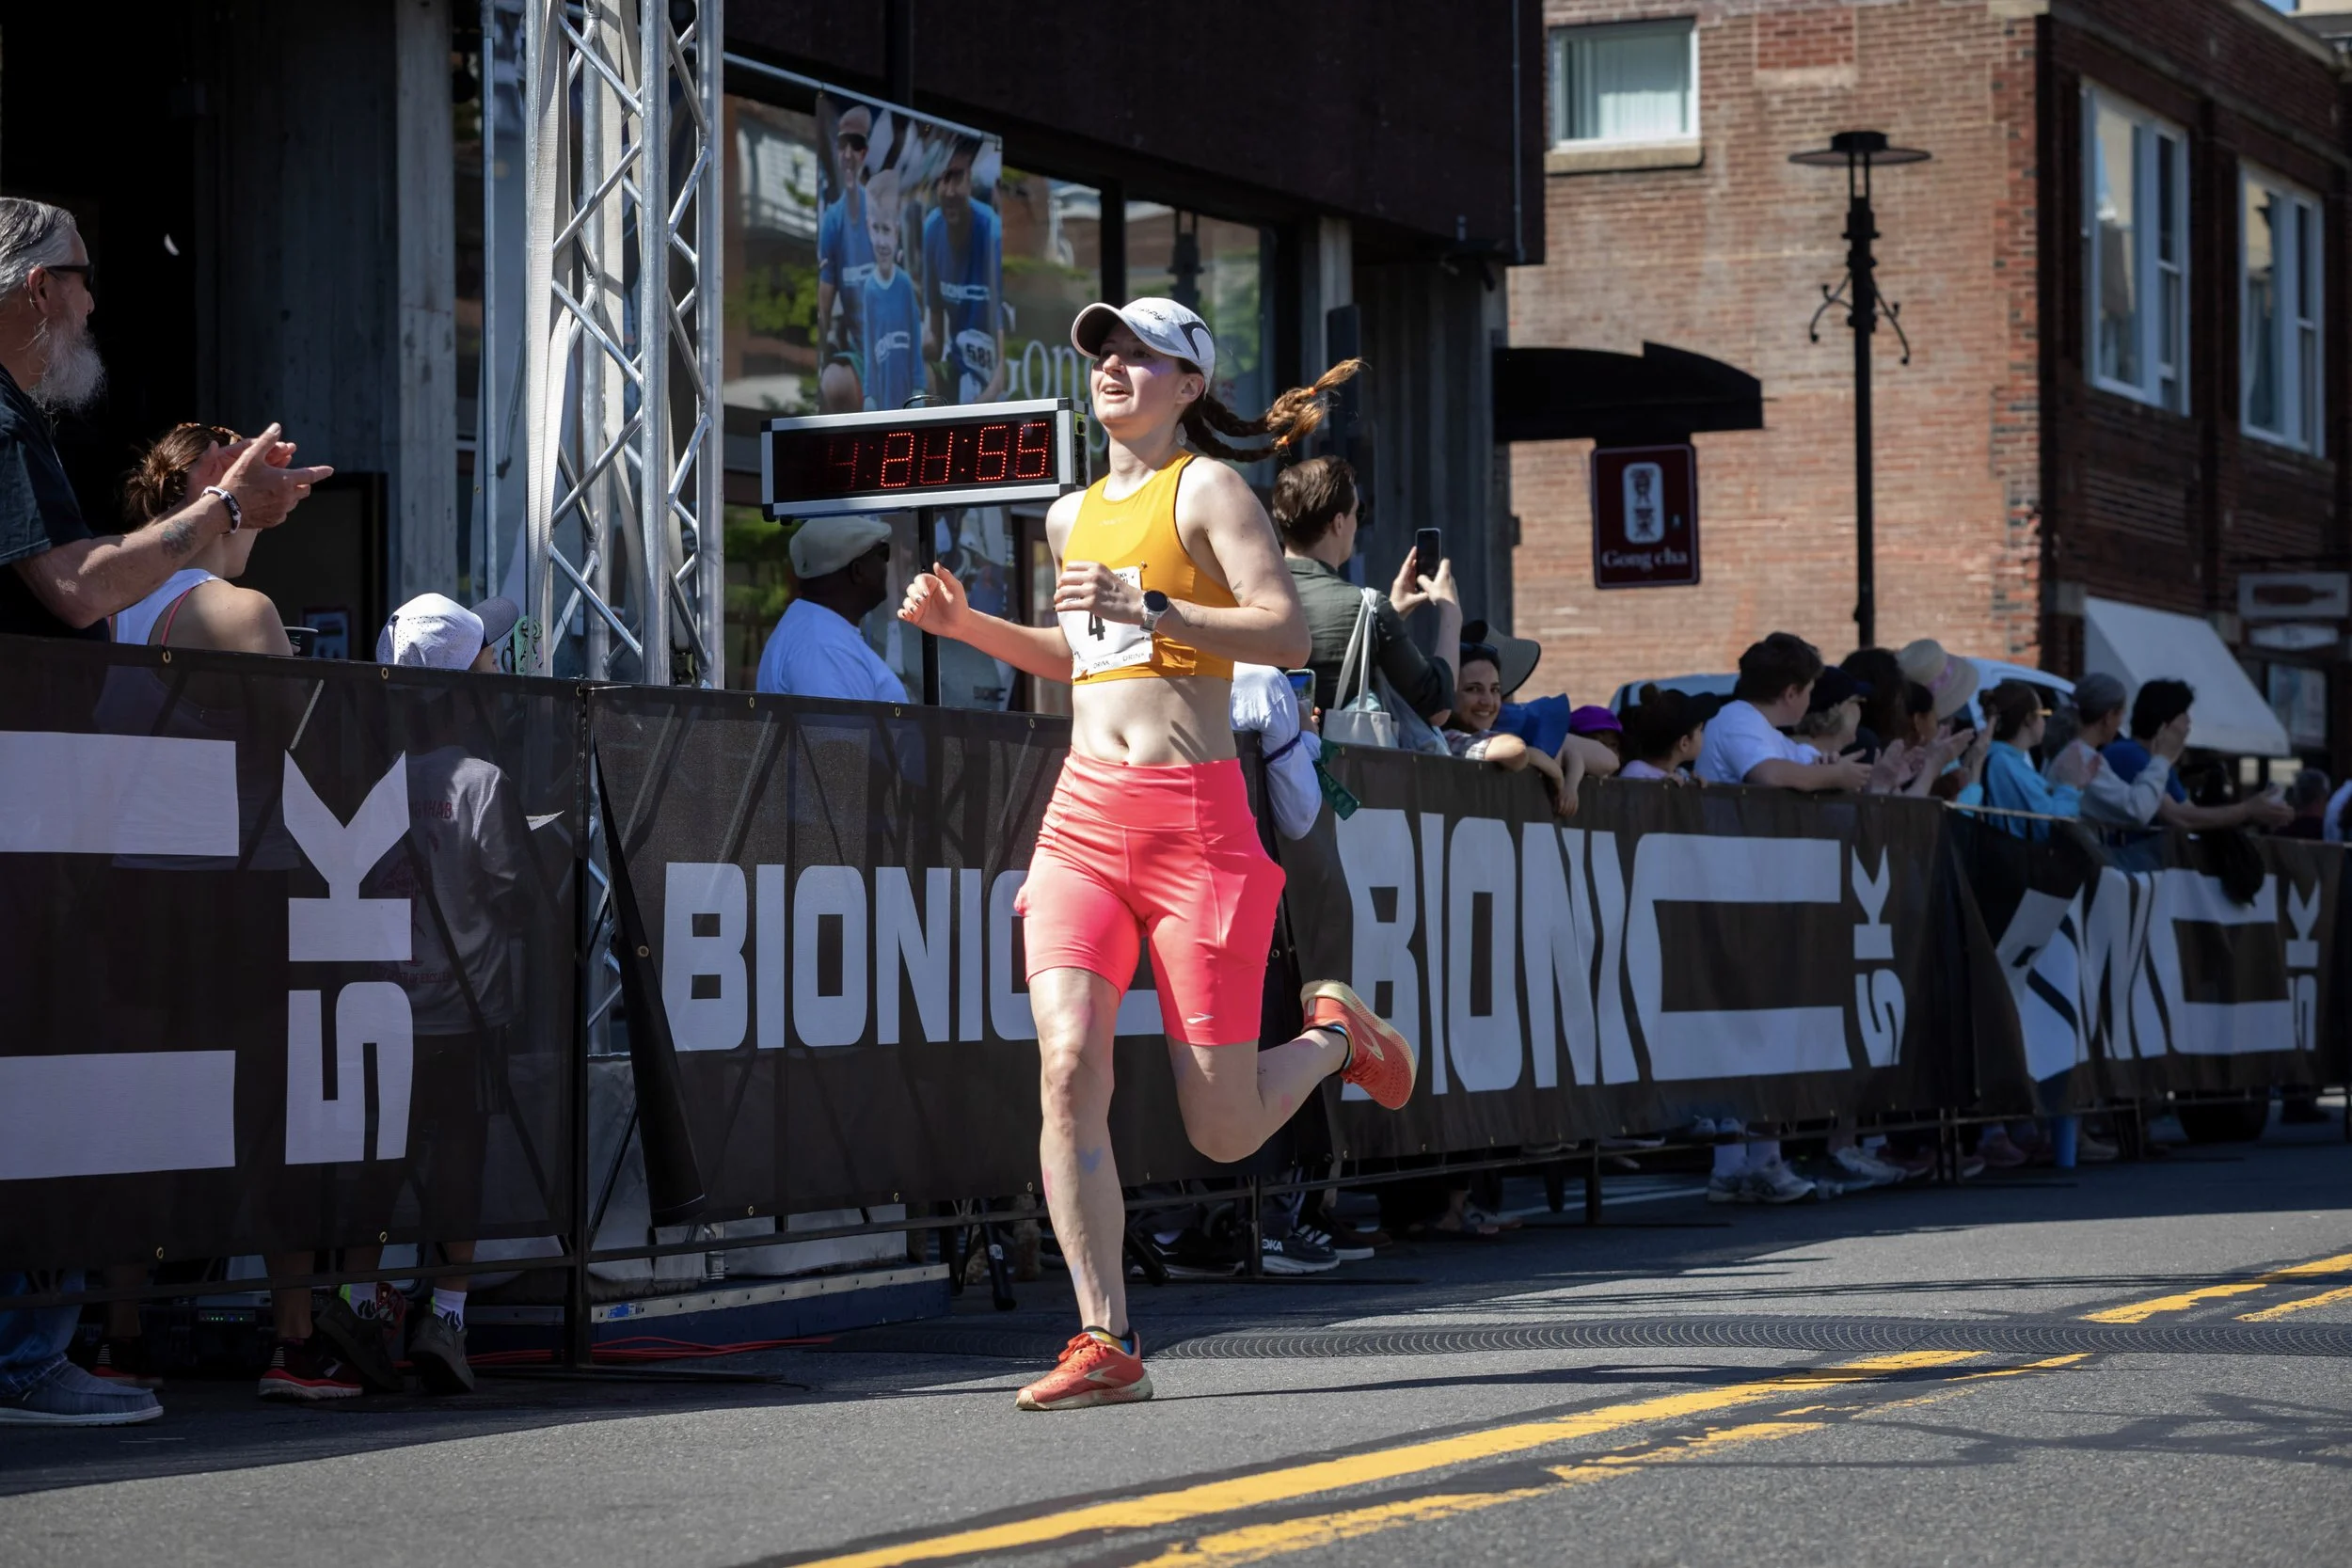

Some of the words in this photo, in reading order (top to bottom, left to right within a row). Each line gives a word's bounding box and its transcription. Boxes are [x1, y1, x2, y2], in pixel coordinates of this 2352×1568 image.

[283, 750, 414, 1165] 5K
[1335, 807, 1853, 1101] BIONIC
[1262, 1238, 1283, 1252] OKA
